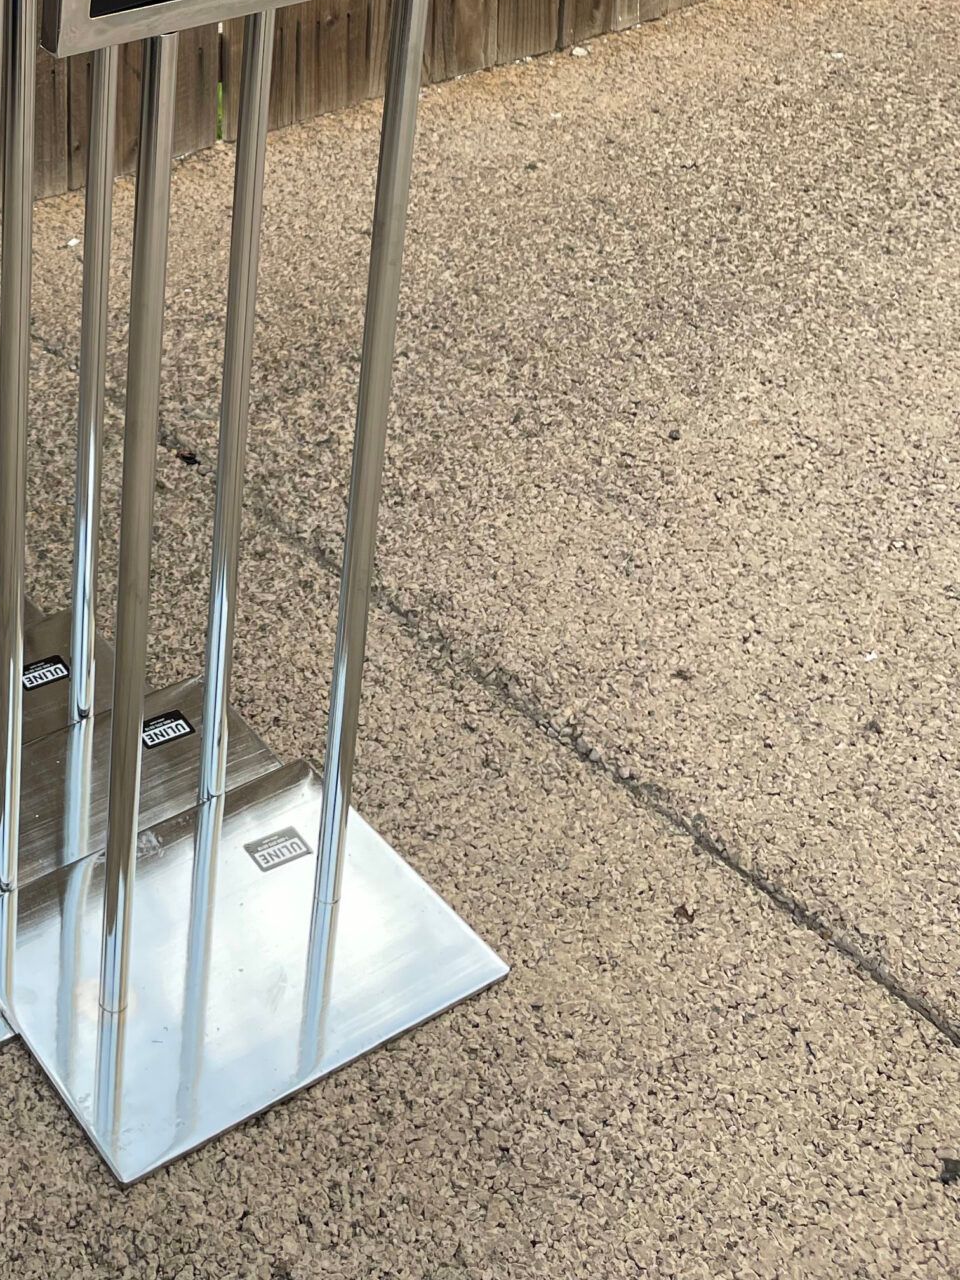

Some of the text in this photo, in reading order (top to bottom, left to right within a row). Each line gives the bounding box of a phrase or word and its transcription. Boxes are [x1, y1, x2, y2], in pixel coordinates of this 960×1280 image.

[24, 666, 66, 686] ULINE
[146, 722, 188, 743] ULINE
[259, 840, 303, 865] ULINE
